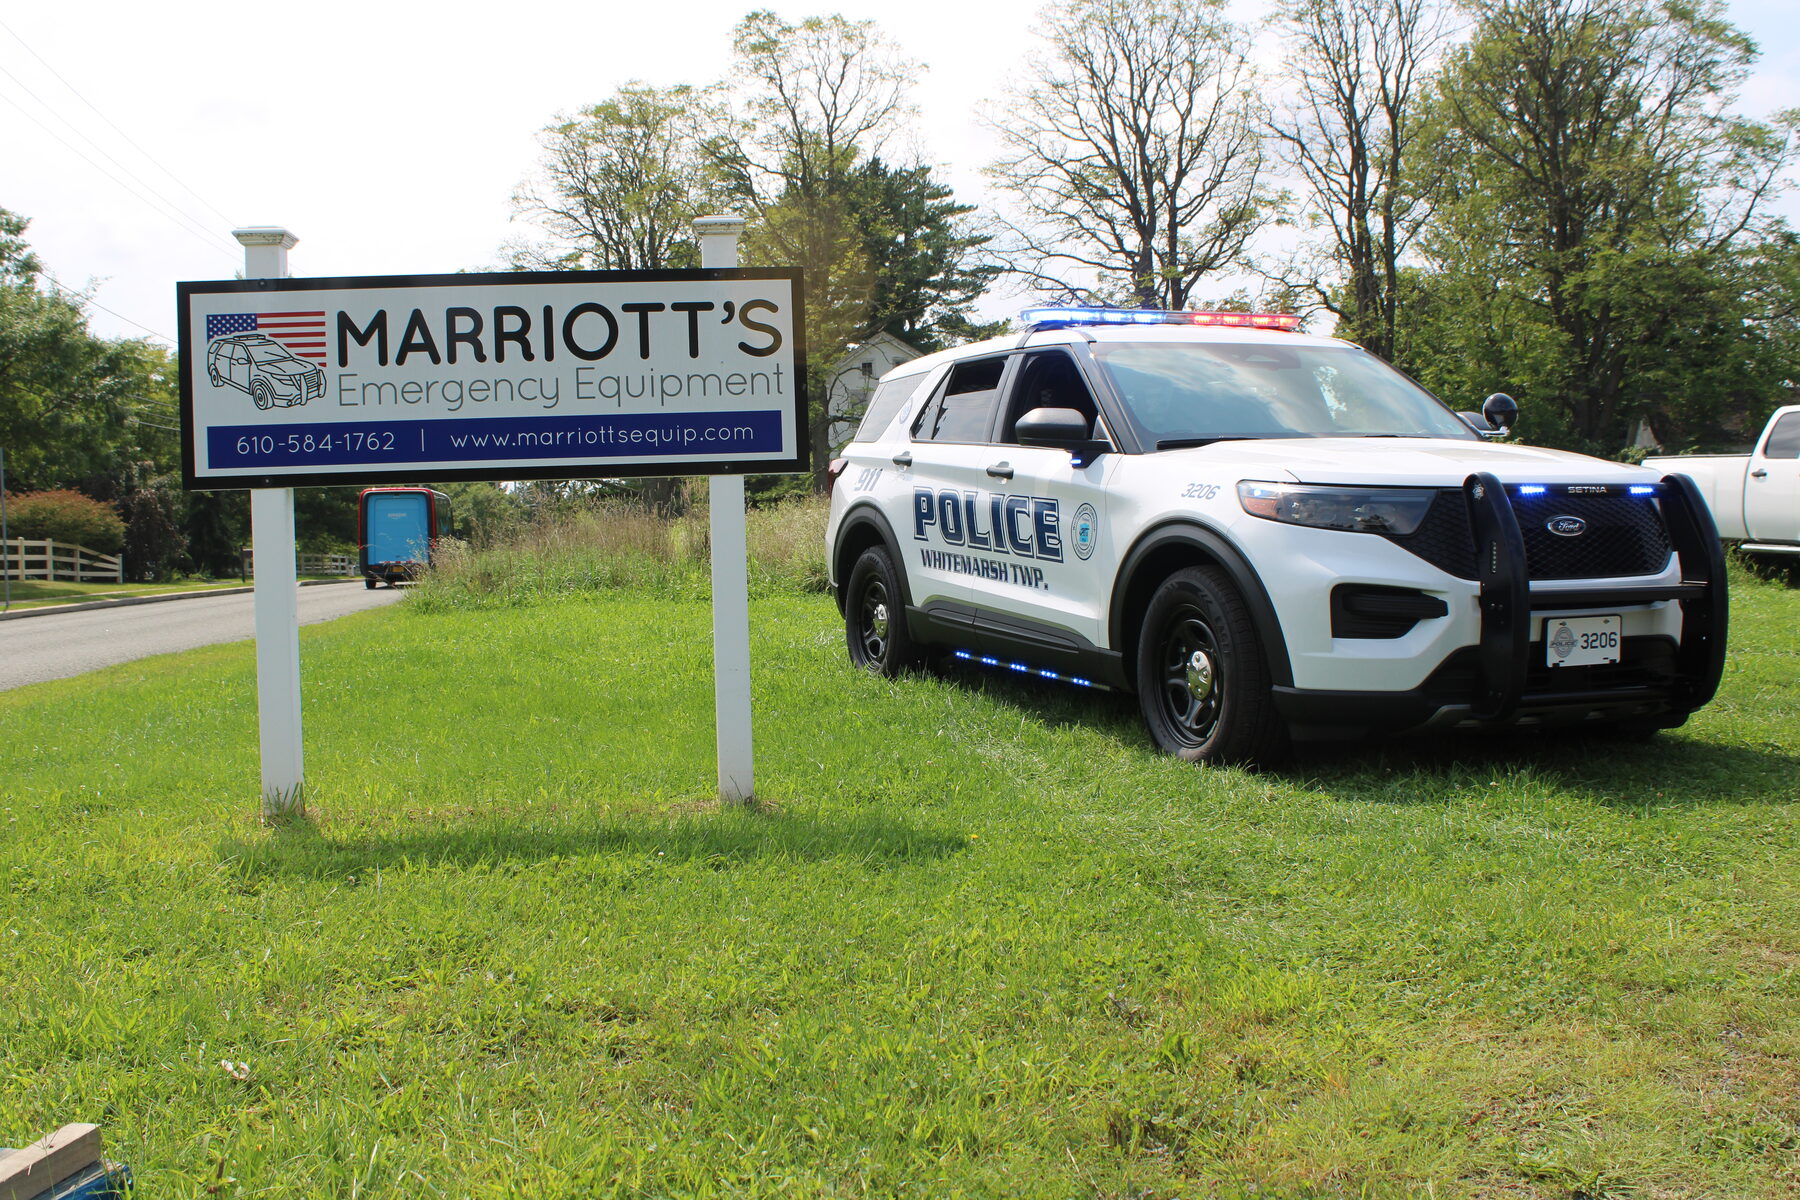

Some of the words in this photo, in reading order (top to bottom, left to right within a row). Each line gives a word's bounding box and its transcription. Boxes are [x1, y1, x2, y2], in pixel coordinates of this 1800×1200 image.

[337, 299, 782, 368] MARRIOTT'S
[338, 373, 560, 411] Emergency
[575, 363, 784, 407] Equipment
[236, 431, 395, 455] 610-584-1762
[450, 425, 754, 448] www.marriottsequip.com
[854, 468, 883, 491] 911
[1181, 483, 1221, 500] 3206
[1567, 486, 1608, 494] SETINA
[913, 486, 1064, 564] POLICE
[1558, 520, 1581, 532] Ford
[920, 548, 1009, 583] WHITEMARSH
[1010, 562, 1049, 591] TWP.
[1580, 632, 1618, 649] 3206
